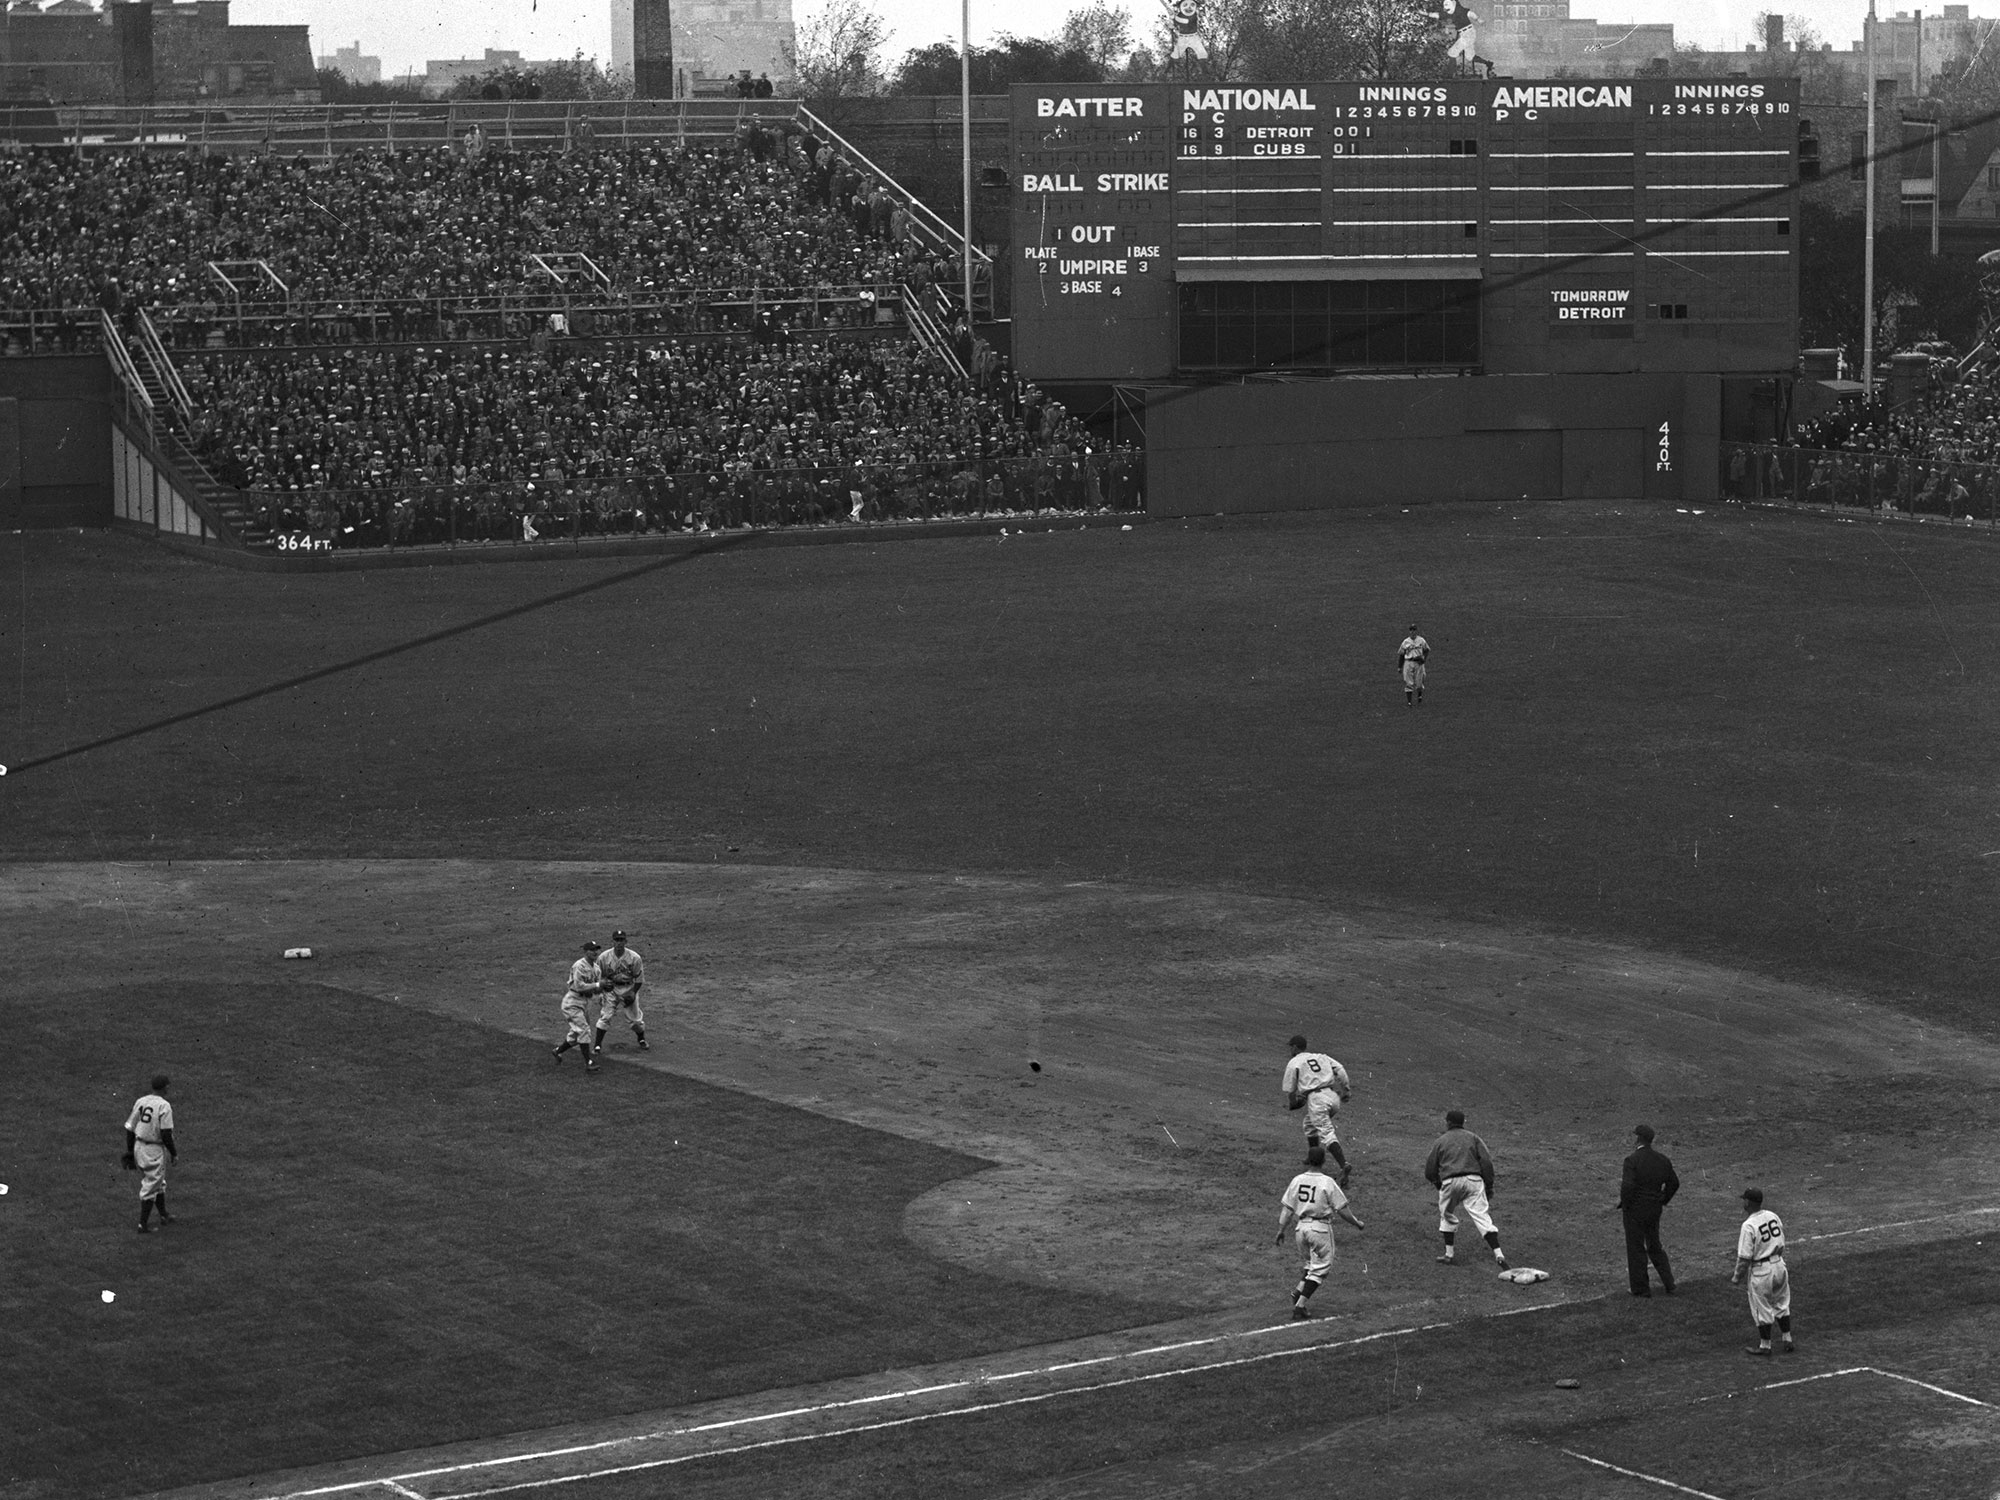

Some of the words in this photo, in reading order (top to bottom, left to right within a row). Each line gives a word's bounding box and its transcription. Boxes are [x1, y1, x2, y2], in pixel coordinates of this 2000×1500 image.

[1360, 87, 1446, 101] INNINGS
[1492, 86, 1631, 107] AMERICAN
[1675, 85, 1764, 98] INNINGS
[1184, 89, 1315, 110] NATIONAL
[1038, 98, 1143, 117] BATTER
[1335, 107, 1341, 118] 1
[1348, 107, 1358, 118] 2
[1363, 107, 1372, 119] 3
[1377, 107, 1388, 118] 4
[1392, 107, 1402, 117] 5
[1407, 107, 1417, 118] 6
[1422, 106, 1432, 118] 7
[1436, 106, 1447, 117] 8
[1450, 106, 1461, 117] 9
[1464, 106, 1477, 117] 10
[1649, 105, 1654, 115] 1
[1662, 105, 1671, 116] 2
[1676, 104, 1687, 115] 3
[1690, 104, 1702, 115] 4
[1705, 104, 1715, 115] 5
[1721, 104, 1730, 115] 6
[1735, 103, 1745, 114] 7
[1749, 104, 1759, 115] 8
[1765, 103, 1774, 114] 9
[1778, 103, 1790, 114] 10
[1183, 113, 1196, 124] P
[1212, 112, 1225, 124] C
[1496, 110, 1509, 120] P
[1524, 110, 1538, 121] C
[1184, 128, 1197, 138] 16
[1214, 127, 1224, 139] 3
[1247, 128, 1313, 138] DETROIT
[1333, 127, 1344, 137] 0
[1348, 126, 1359, 137] 0
[1366, 127, 1371, 137] 1
[1184, 145, 1197, 155] 16
[1214, 145, 1223, 155] 9
[1254, 144, 1305, 155] CUBS
[1333, 144, 1344, 154] 0
[1350, 144, 1355, 154] 1
[1024, 175, 1083, 192] BALL
[1098, 174, 1168, 191] STRIKE
[1057, 229, 1062, 240] 1
[1072, 226, 1115, 243] OUT
[1025, 247, 1057, 258] PLATE
[1127, 247, 1132, 258] 1
[1134, 246, 1159, 257] BASE
[1038, 262, 1048, 274] 2
[1060, 260, 1127, 275] UMPIRE
[1138, 261, 1148, 273] 3
[1060, 282, 1070, 294] 3
[1072, 281, 1102, 293] BASE
[1111, 286, 1122, 297] 4
[1551, 290, 1629, 302] TOMORROW
[1559, 307, 1625, 319] DETROIT
[1658, 422, 1670, 461] 440
[1657, 462, 1672, 471] FT.
[278, 535, 312, 550] 364
[315, 540, 332, 550] FT.
[1307, 1059, 1321, 1073] 8
[139, 1105, 153, 1123] 16
[1298, 1184, 1317, 1203] 51
[1759, 1219, 1781, 1243] 56
